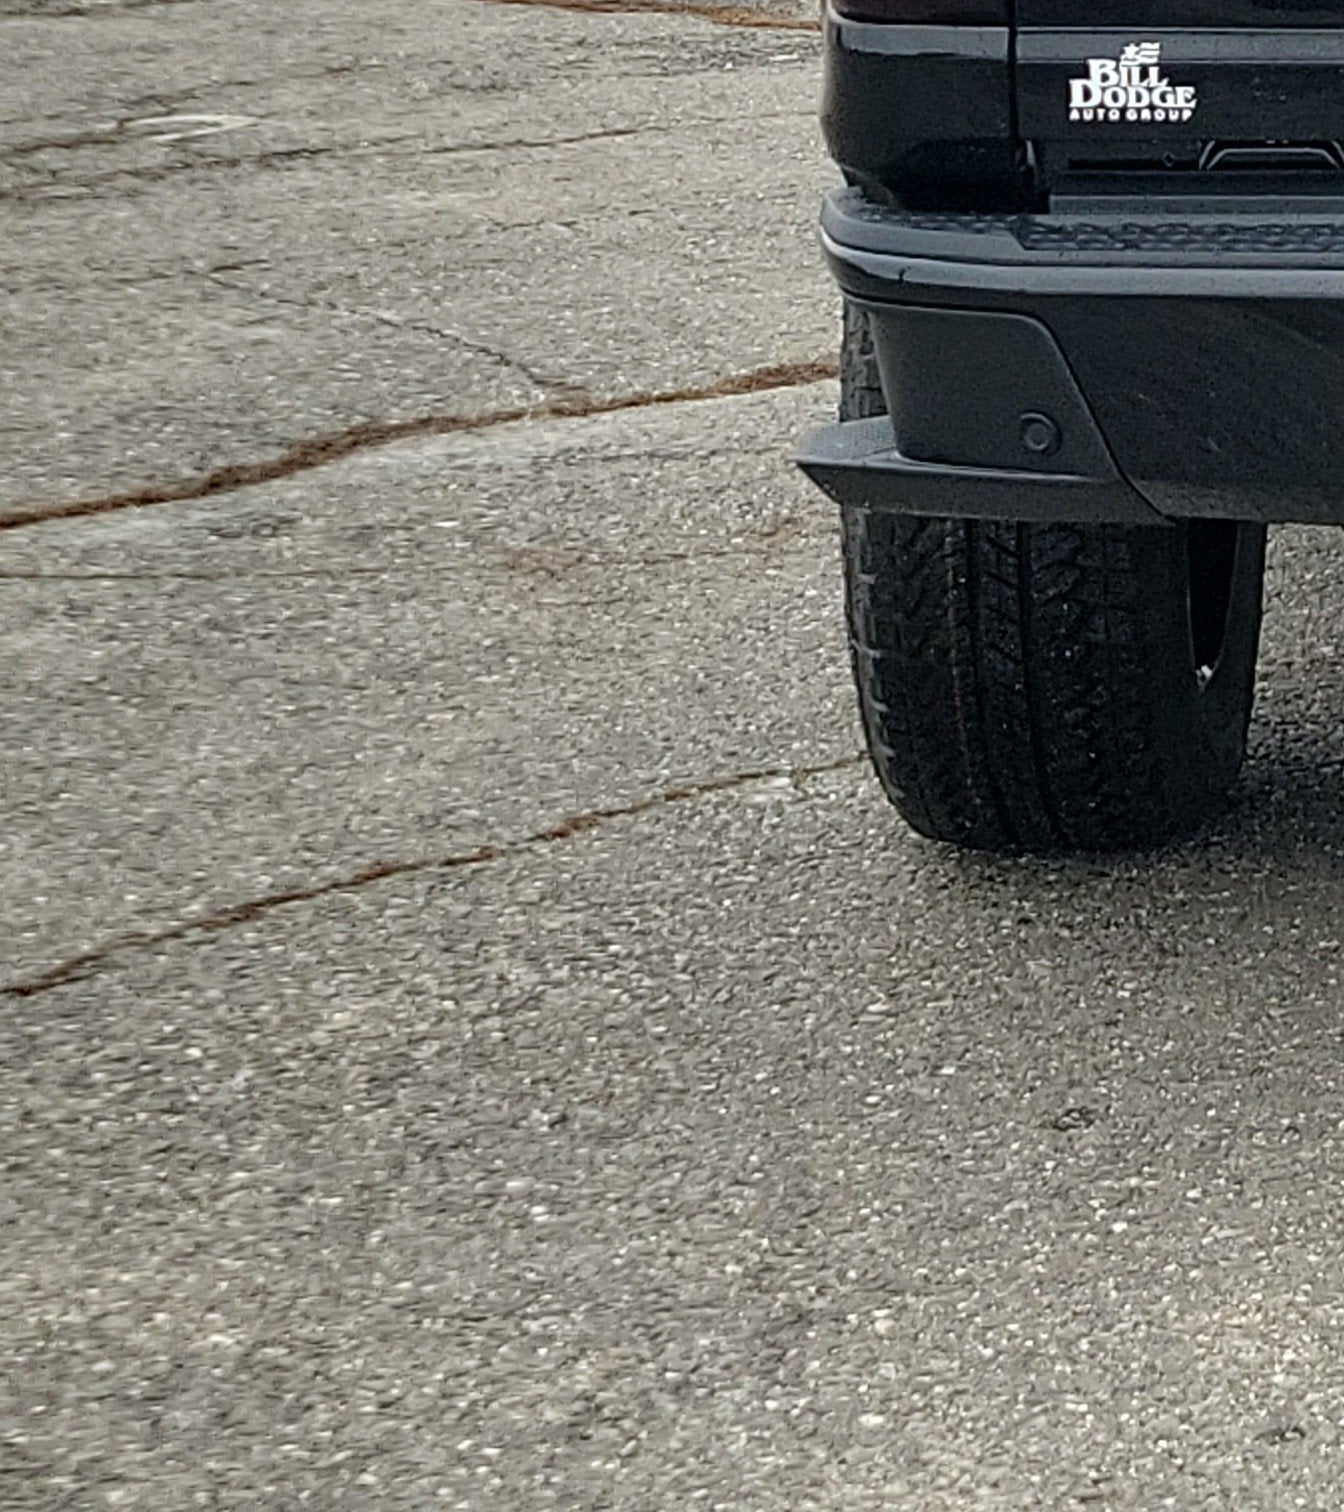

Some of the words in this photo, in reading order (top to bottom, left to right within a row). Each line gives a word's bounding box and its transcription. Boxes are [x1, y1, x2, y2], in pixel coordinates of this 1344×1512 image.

[1086, 58, 1169, 88] BILL
[1069, 78, 1197, 109] DODGE
[1069, 108, 1120, 122] AUTO
[1125, 108, 1192, 122] GROUP
